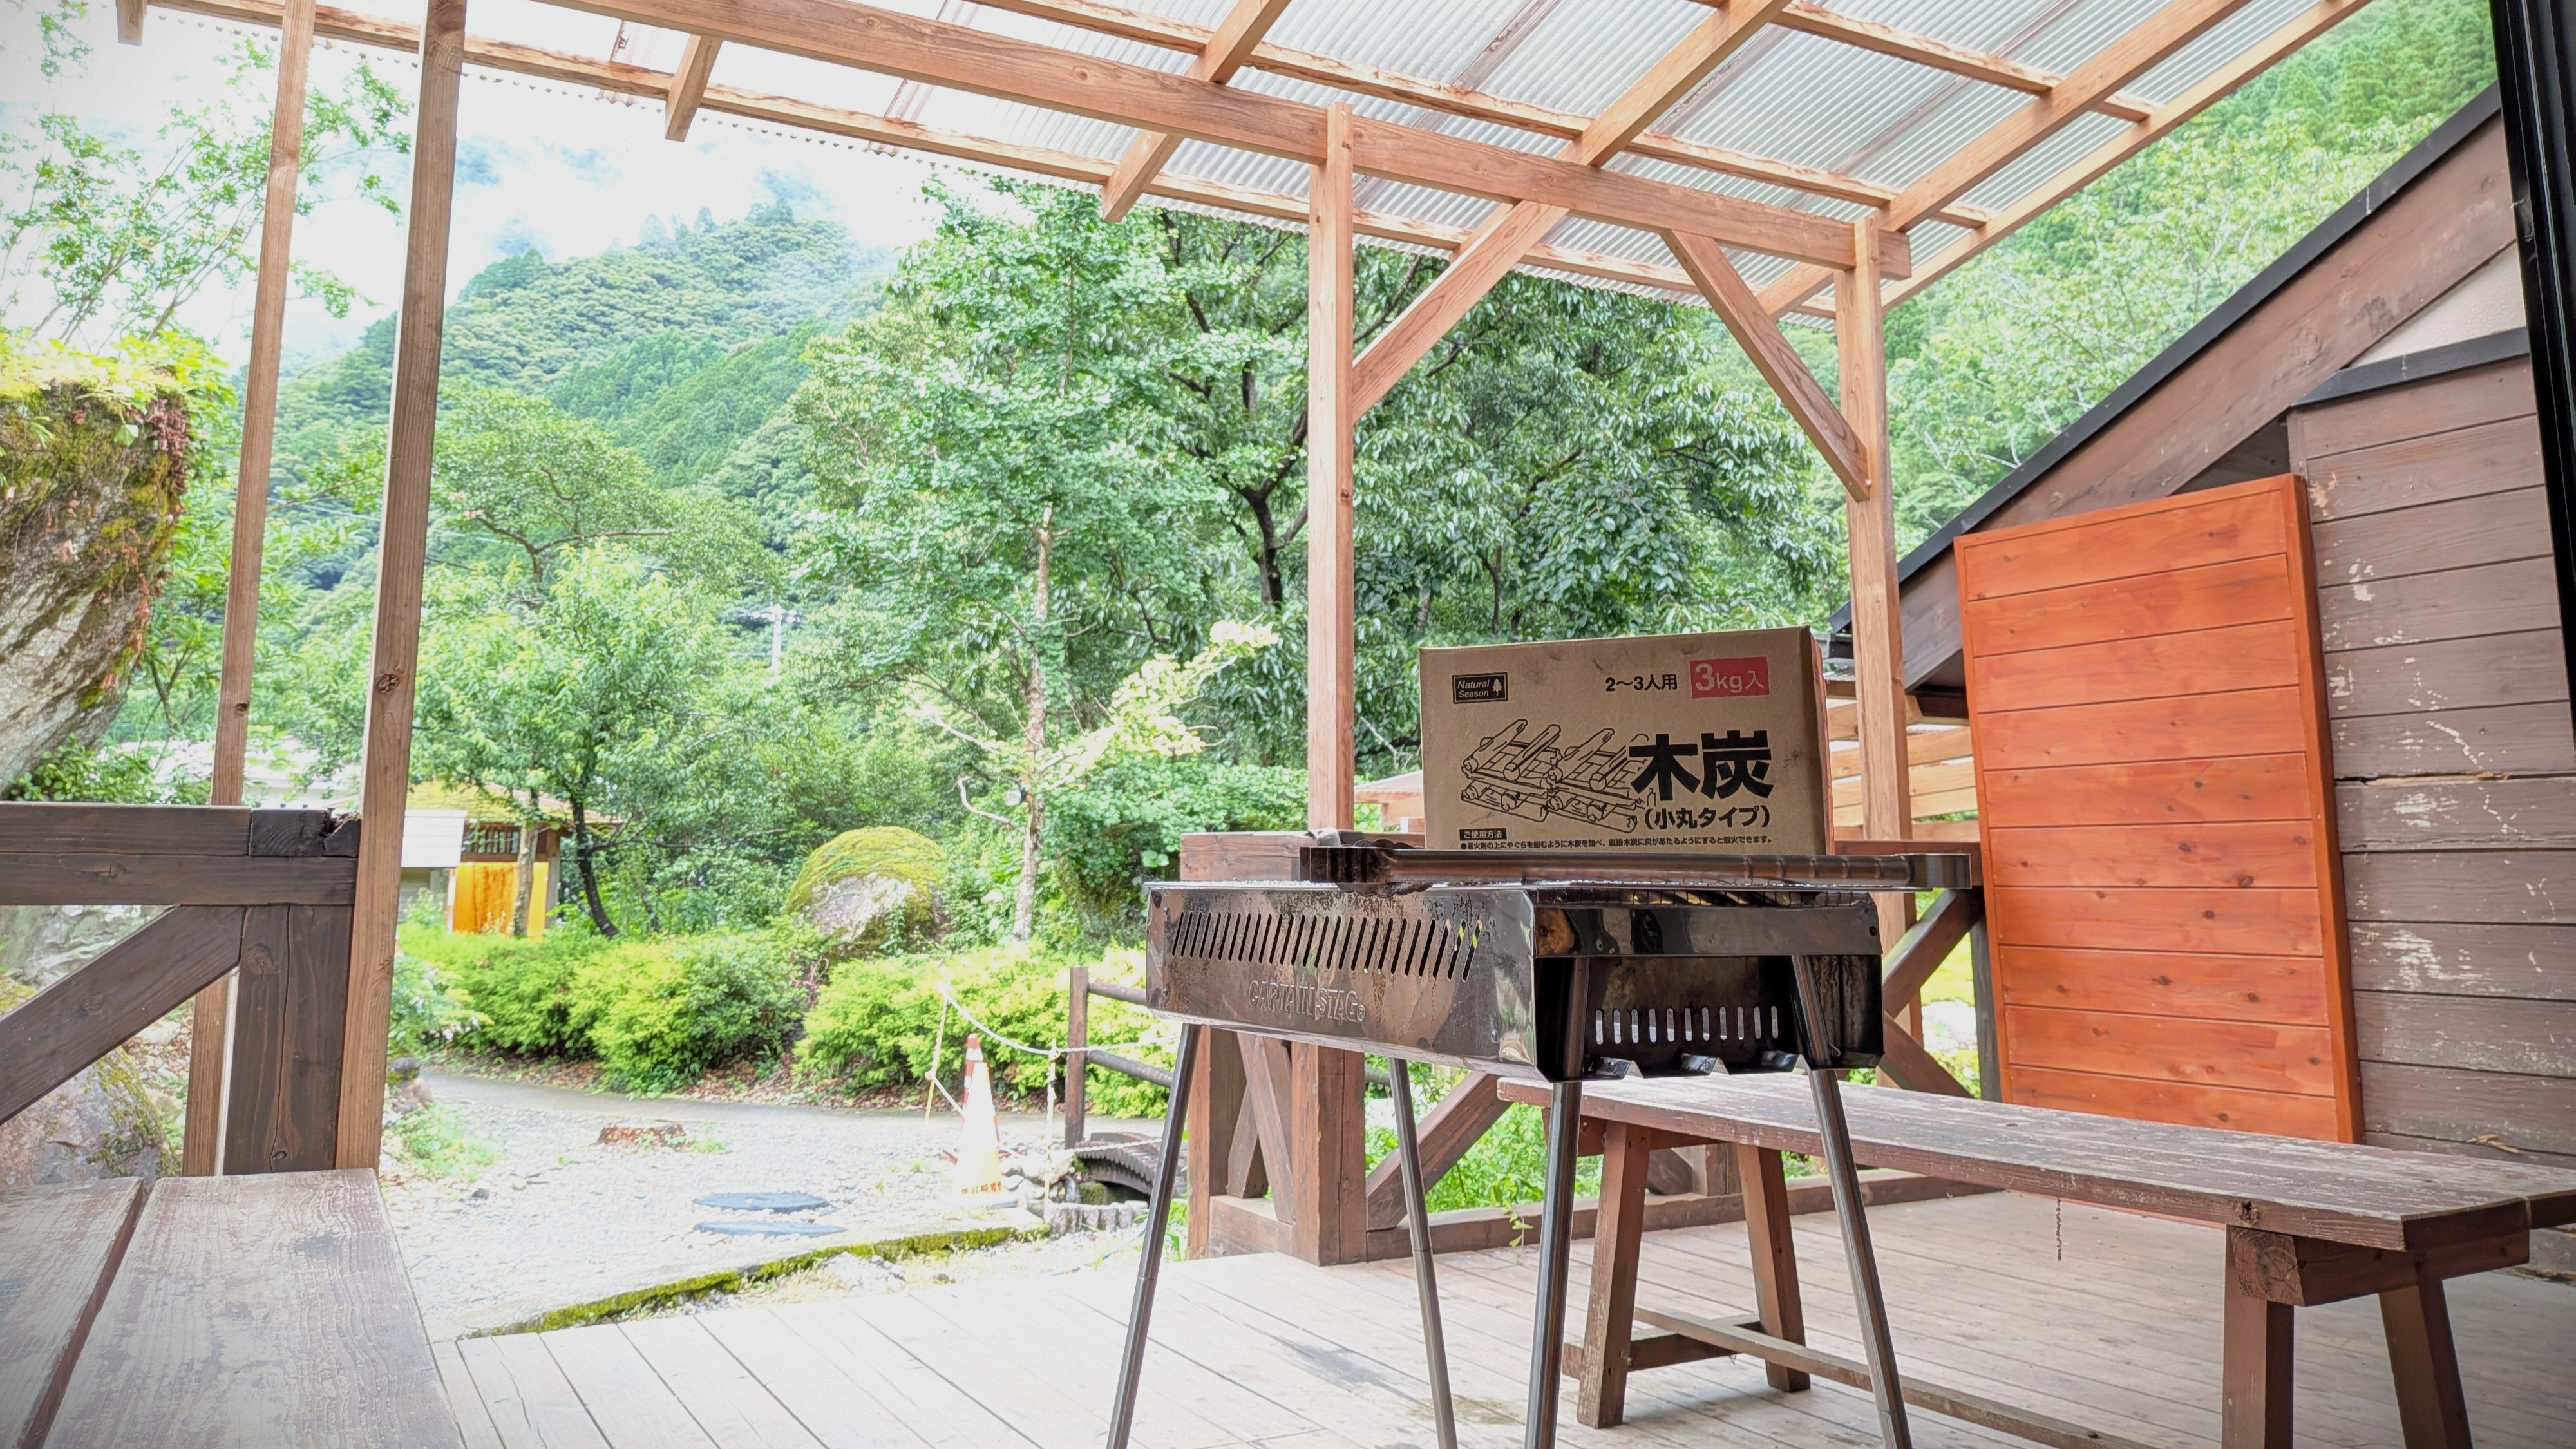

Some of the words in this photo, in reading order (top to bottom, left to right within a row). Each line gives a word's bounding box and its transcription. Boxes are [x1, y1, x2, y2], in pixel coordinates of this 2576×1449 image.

[1457, 679, 1490, 689] Natural
[1694, 663, 1765, 692] 3kg入
[1459, 690, 1489, 698] Season
[1629, 730, 1774, 801] 木炭
[1463, 830, 1502, 839] ご使用方法
[1248, 980, 1315, 1016] CAPTAIN
